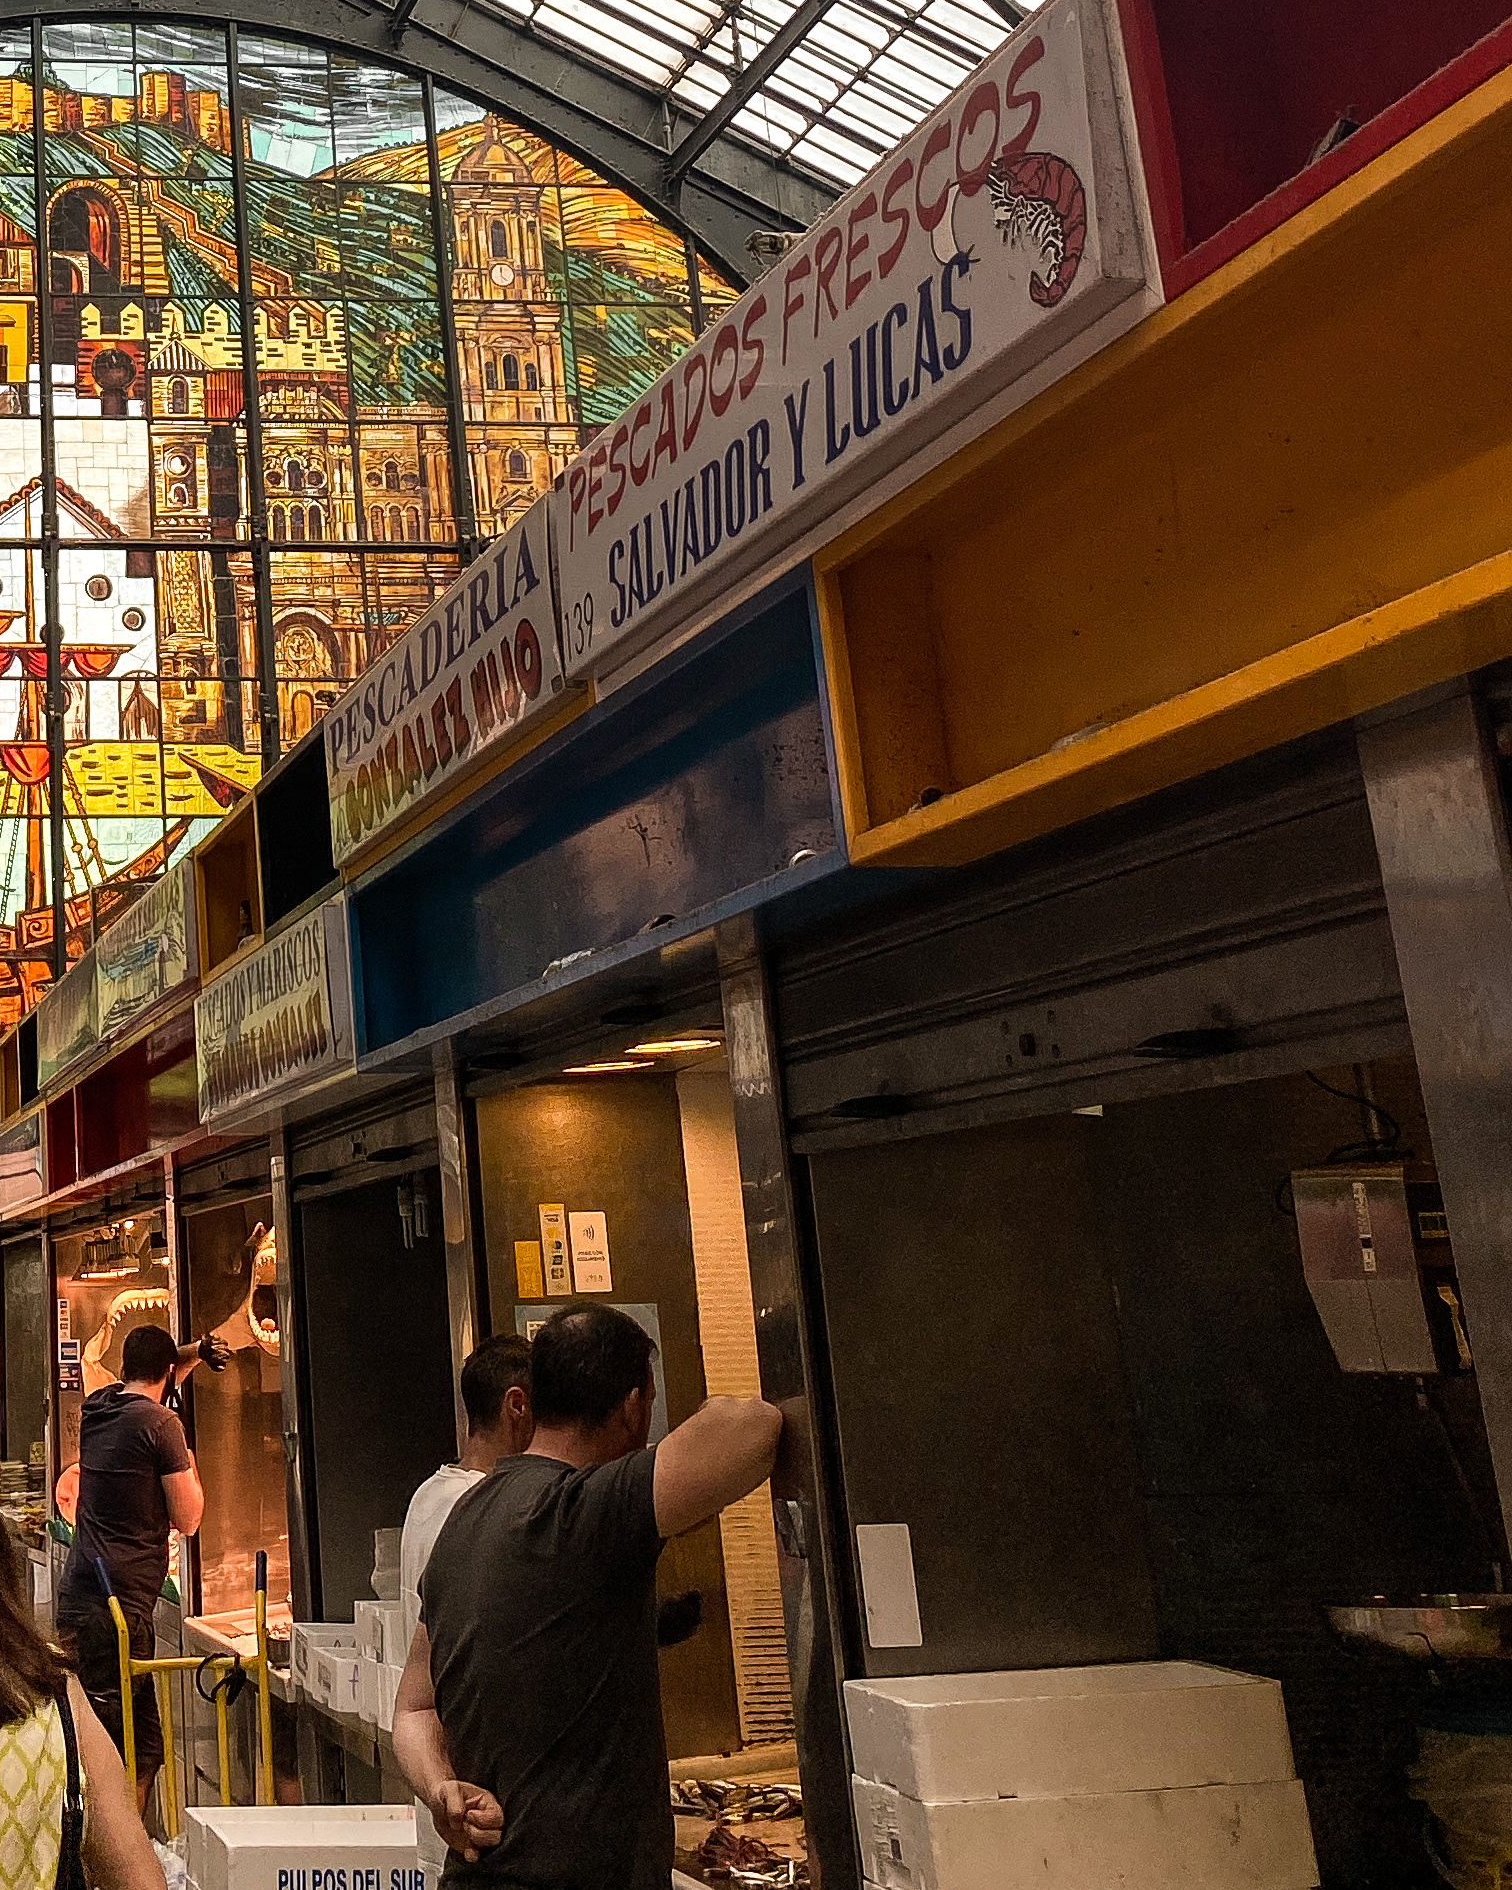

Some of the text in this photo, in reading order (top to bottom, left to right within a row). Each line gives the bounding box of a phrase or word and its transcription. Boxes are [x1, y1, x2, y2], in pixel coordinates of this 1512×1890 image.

[569, 37, 1046, 552] PESCADOS FRESCOS
[609, 252, 974, 628] SALVADOR Y LUCAS
[329, 526, 540, 778] PESCADERIA
[564, 592, 594, 661] 139
